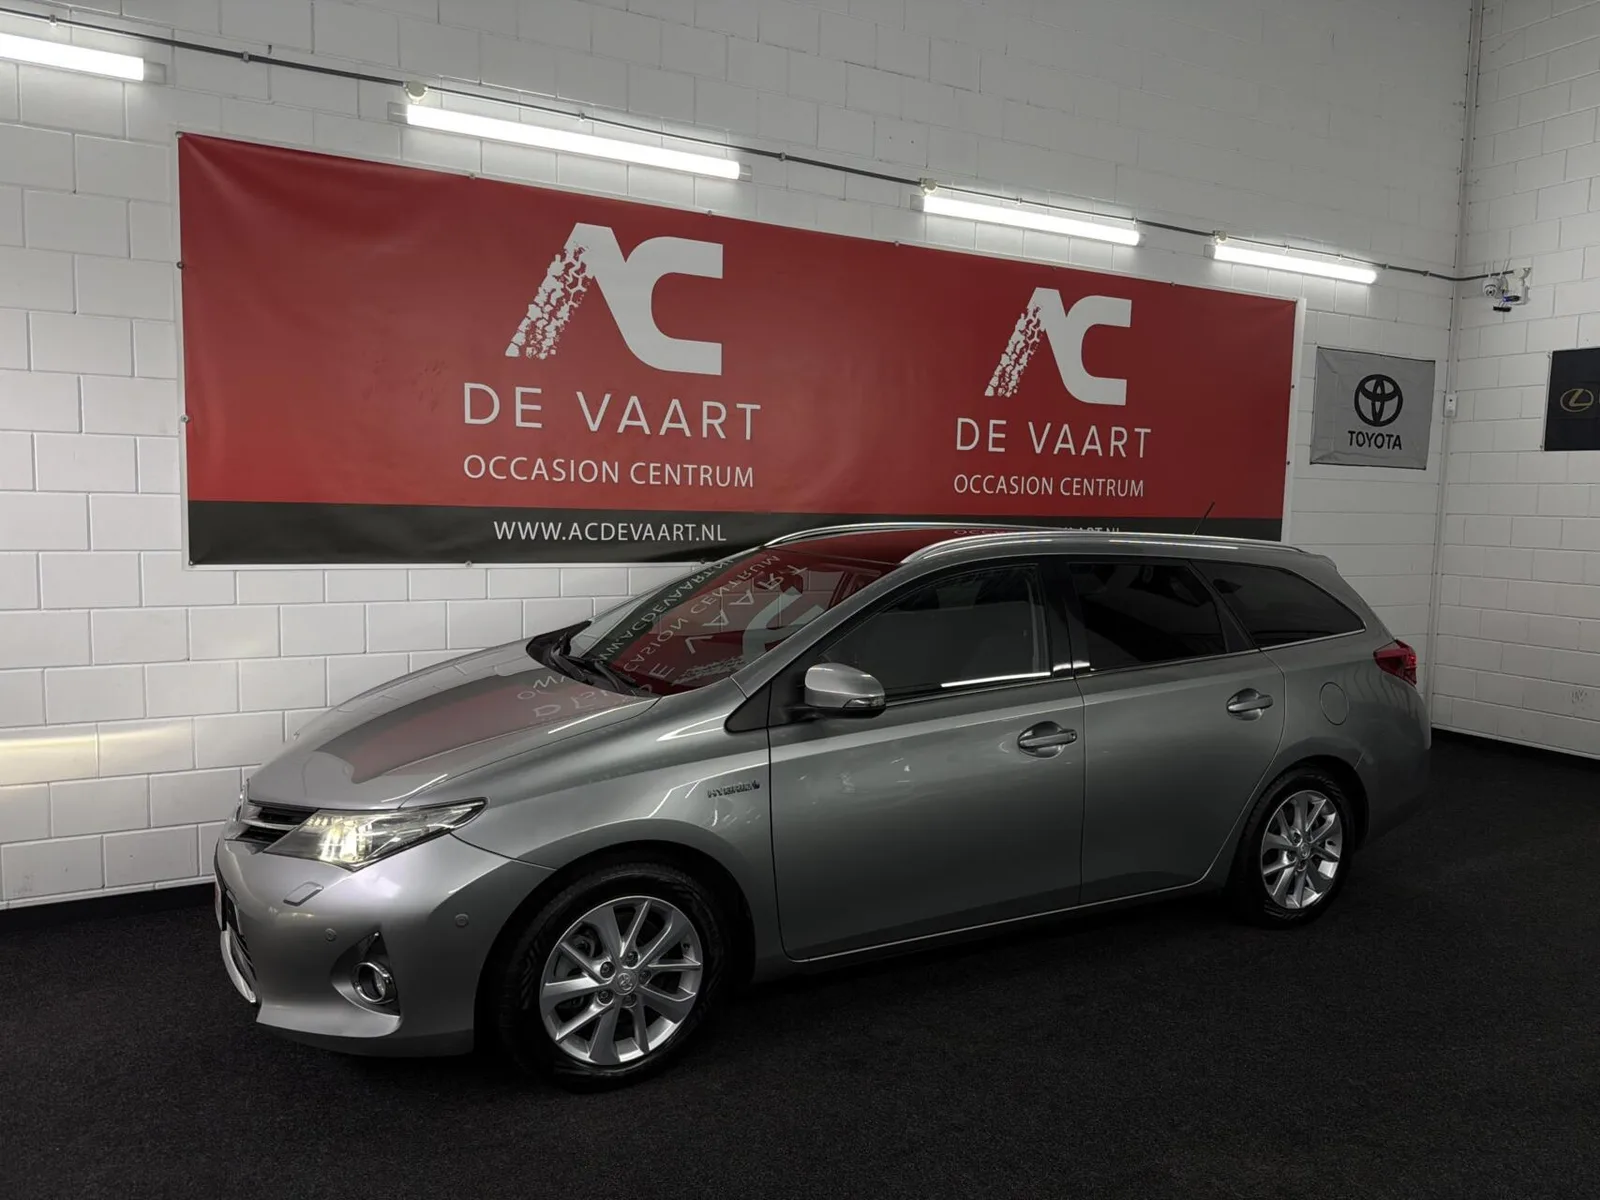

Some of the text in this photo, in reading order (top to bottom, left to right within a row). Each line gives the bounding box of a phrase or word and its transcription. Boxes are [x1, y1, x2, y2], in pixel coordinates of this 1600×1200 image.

[505, 222, 723, 376] AC
[984, 286, 1132, 406] AC
[463, 382, 761, 441] DE VAART
[956, 417, 1152, 459] DE VAART
[1348, 429, 1403, 451] TOYOTA
[463, 454, 755, 489] OCCASION CENTRUM
[953, 473, 1145, 498] OCCASION CENTRUM
[493, 520, 728, 543] WWW.ACDEVAART.NL
